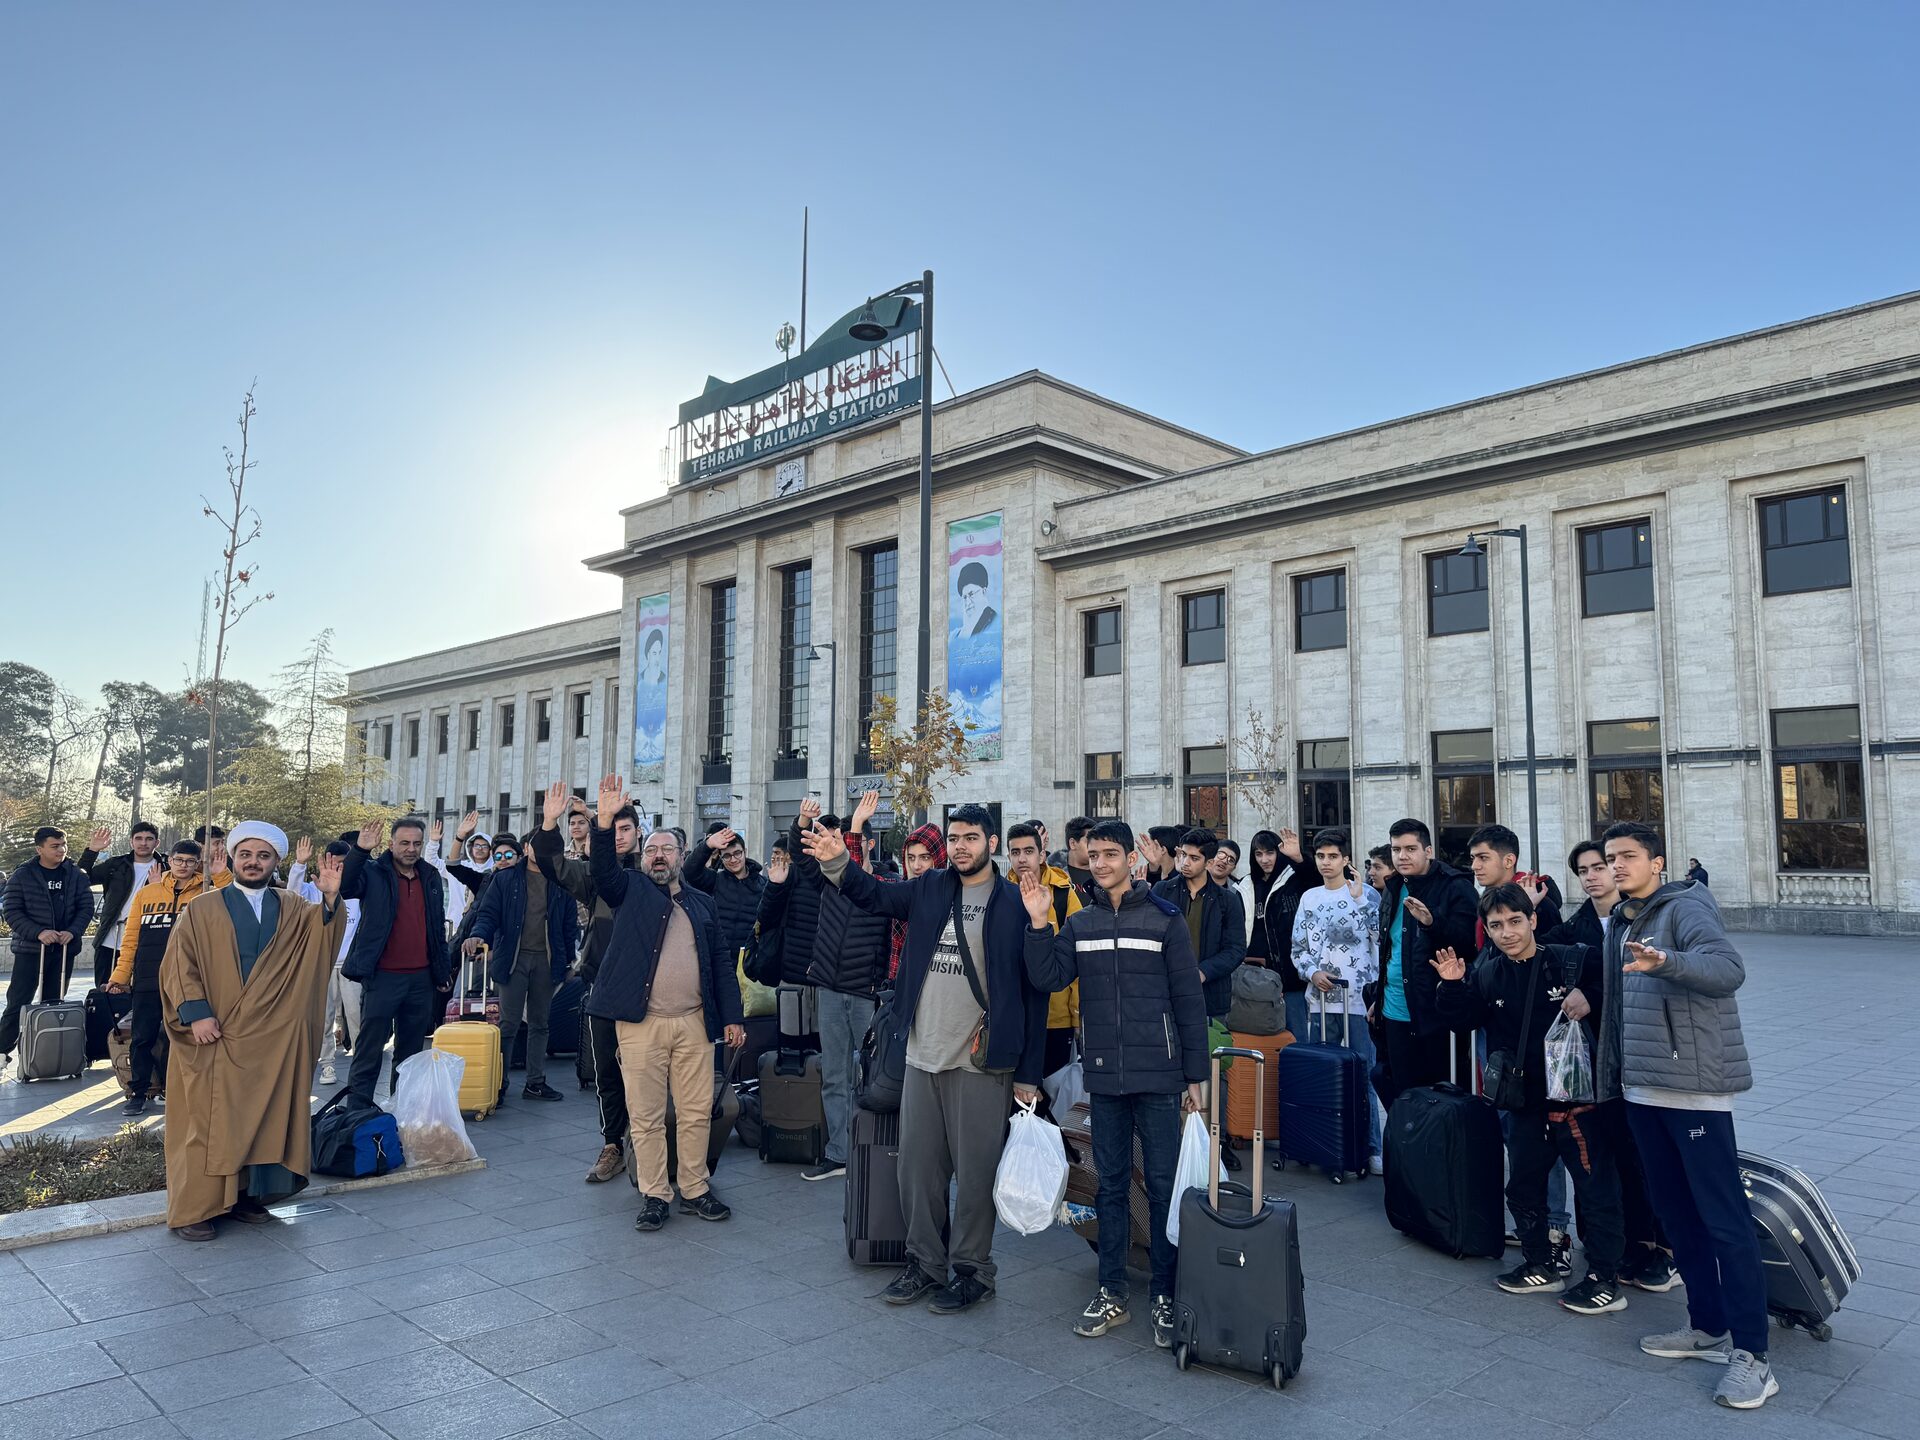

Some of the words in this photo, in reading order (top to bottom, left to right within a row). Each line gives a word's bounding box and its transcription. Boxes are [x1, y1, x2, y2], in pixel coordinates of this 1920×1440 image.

[825, 350, 900, 397] ایستگاه
[692, 443, 745, 473] TEHRAN
[754, 417, 819, 453] RAILWAY
[828, 387, 899, 426] STATION
